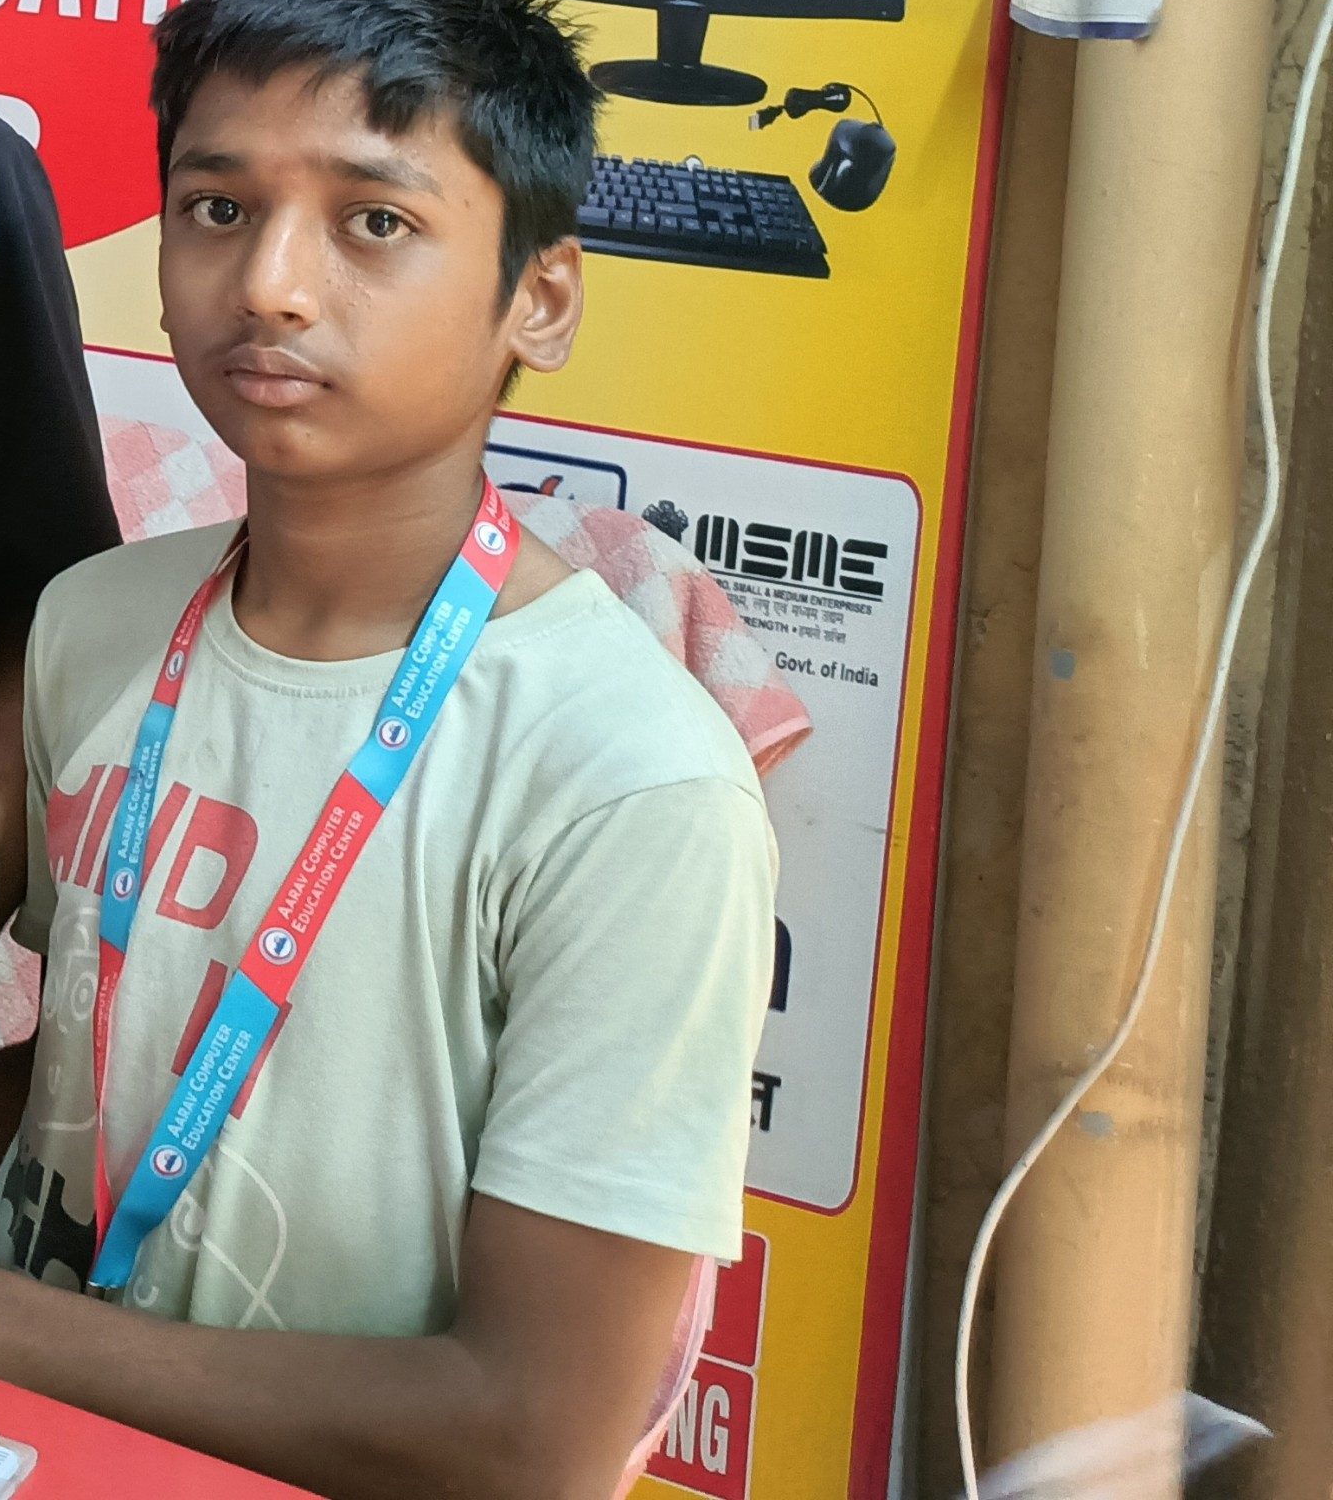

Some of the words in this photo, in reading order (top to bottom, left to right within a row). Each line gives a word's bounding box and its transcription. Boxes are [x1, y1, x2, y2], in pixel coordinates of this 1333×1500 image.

[694, 514, 888, 596] MSME
[733, 583, 762, 596] SMALL
[774, 588, 808, 603] MEDIUM
[810, 595, 872, 615] ENTERPRISES
[391, 666, 420, 709] AARAV
[412, 601, 454, 664] COMPUTER
[405, 656, 448, 720] EDUCATION
[440, 606, 472, 652] CENTER
[741, 615, 788, 633] RENGTH
[775, 652, 815, 676] Govt.
[820, 661, 837, 678] of
[840, 663, 879, 687] India
[277, 876, 308, 920] AARAV
[302, 806, 346, 874] COMPUTER
[291, 858, 337, 934] EDUCATION
[329, 810, 365, 858] CENTER
[166, 1093, 197, 1138] AARAV
[189, 1024, 233, 1092] COMPUTER
[181, 1077, 225, 1151] EDUCATION
[219, 1029, 252, 1080] CENTER
